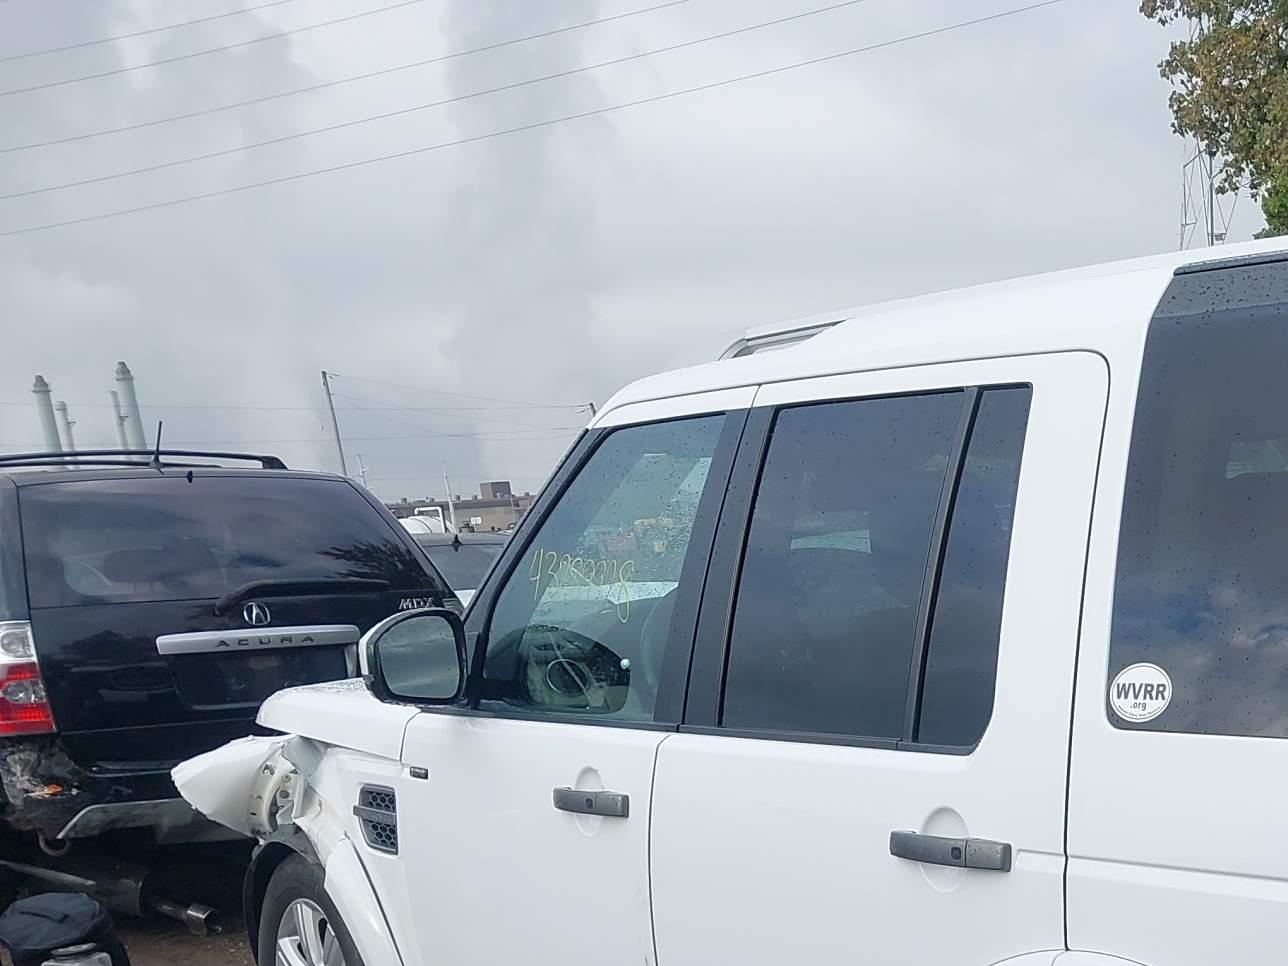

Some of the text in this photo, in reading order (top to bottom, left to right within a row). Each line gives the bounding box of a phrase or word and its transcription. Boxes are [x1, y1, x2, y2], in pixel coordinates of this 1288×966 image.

[398, 597, 434, 610] MDX
[215, 635, 316, 649] ACURA
[1116, 682, 1167, 701] WVRR
[1129, 701, 1148, 712] .org
